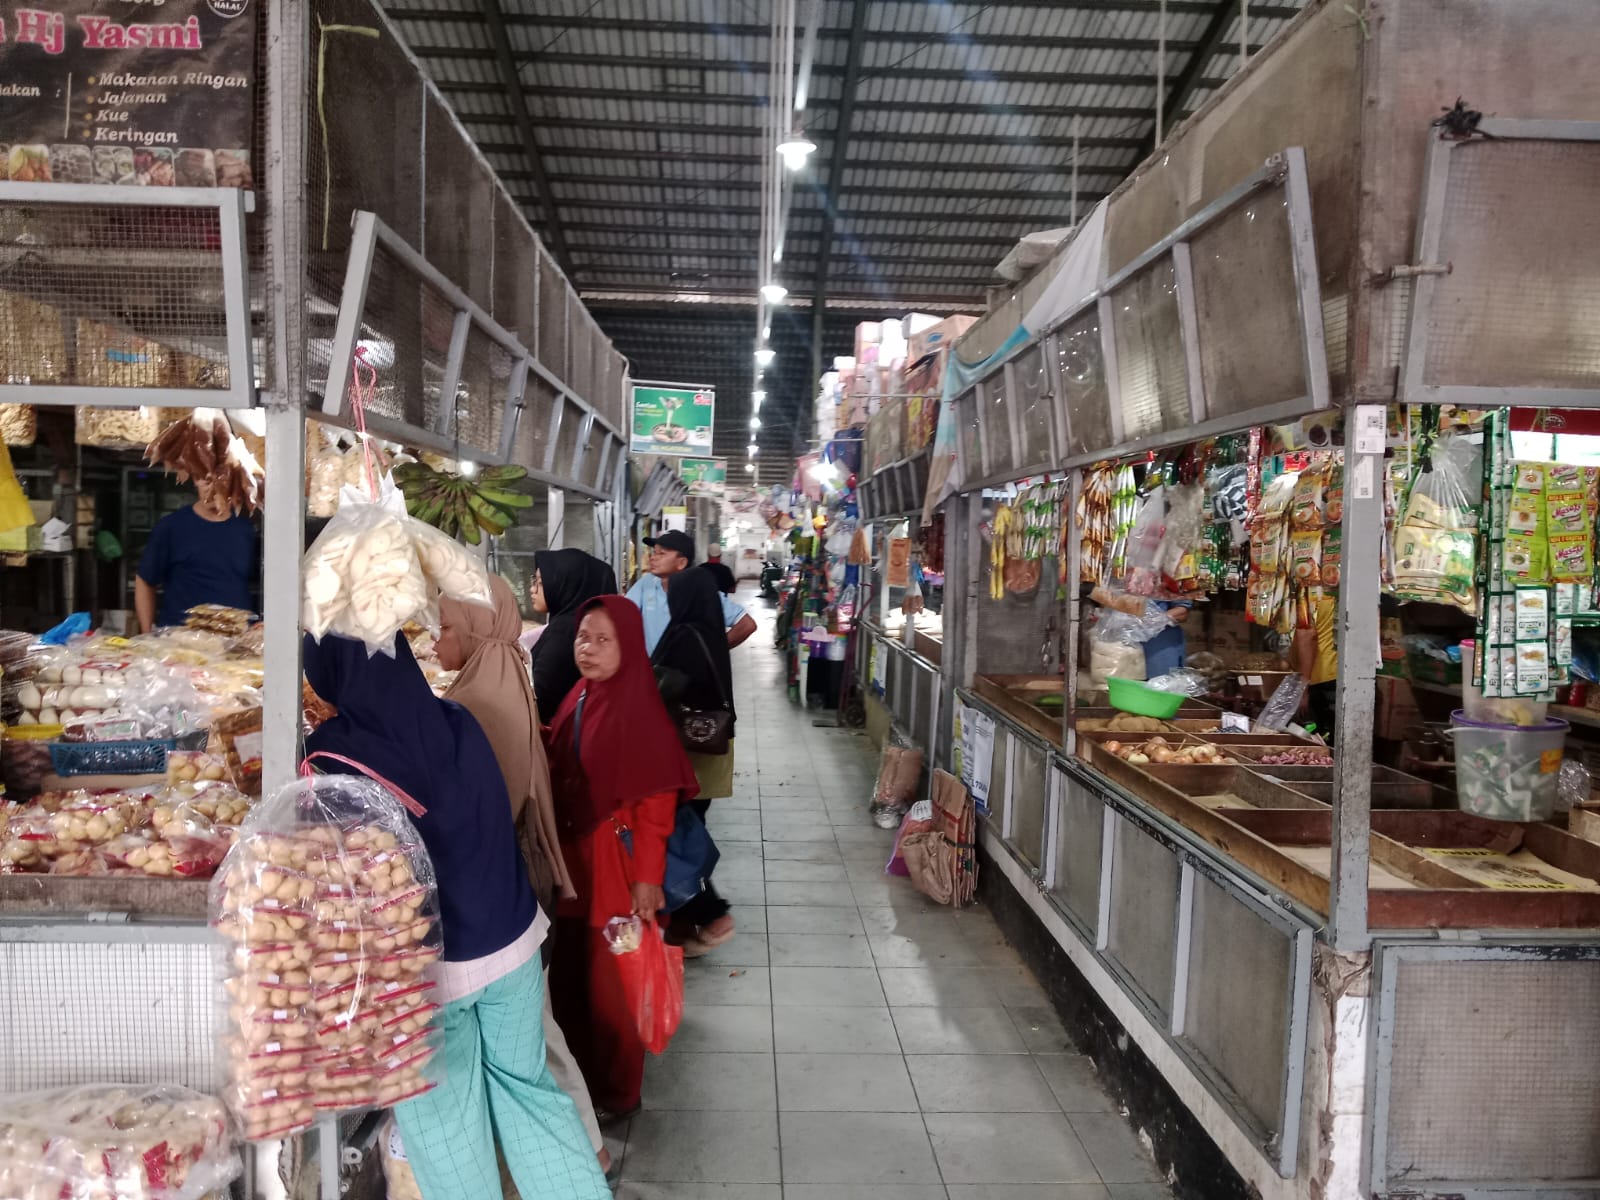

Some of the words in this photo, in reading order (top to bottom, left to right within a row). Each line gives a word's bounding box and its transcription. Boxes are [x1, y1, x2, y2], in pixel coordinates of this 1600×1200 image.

[16, 9, 65, 54] Hj
[77, 15, 202, 49] Yasmi
[98, 72, 178, 87] Makanan
[183, 72, 248, 89] Ringan
[97, 91, 167, 105] Jajanan
[95, 110, 129, 122] Kue
[94, 127, 178, 145] Keringan
